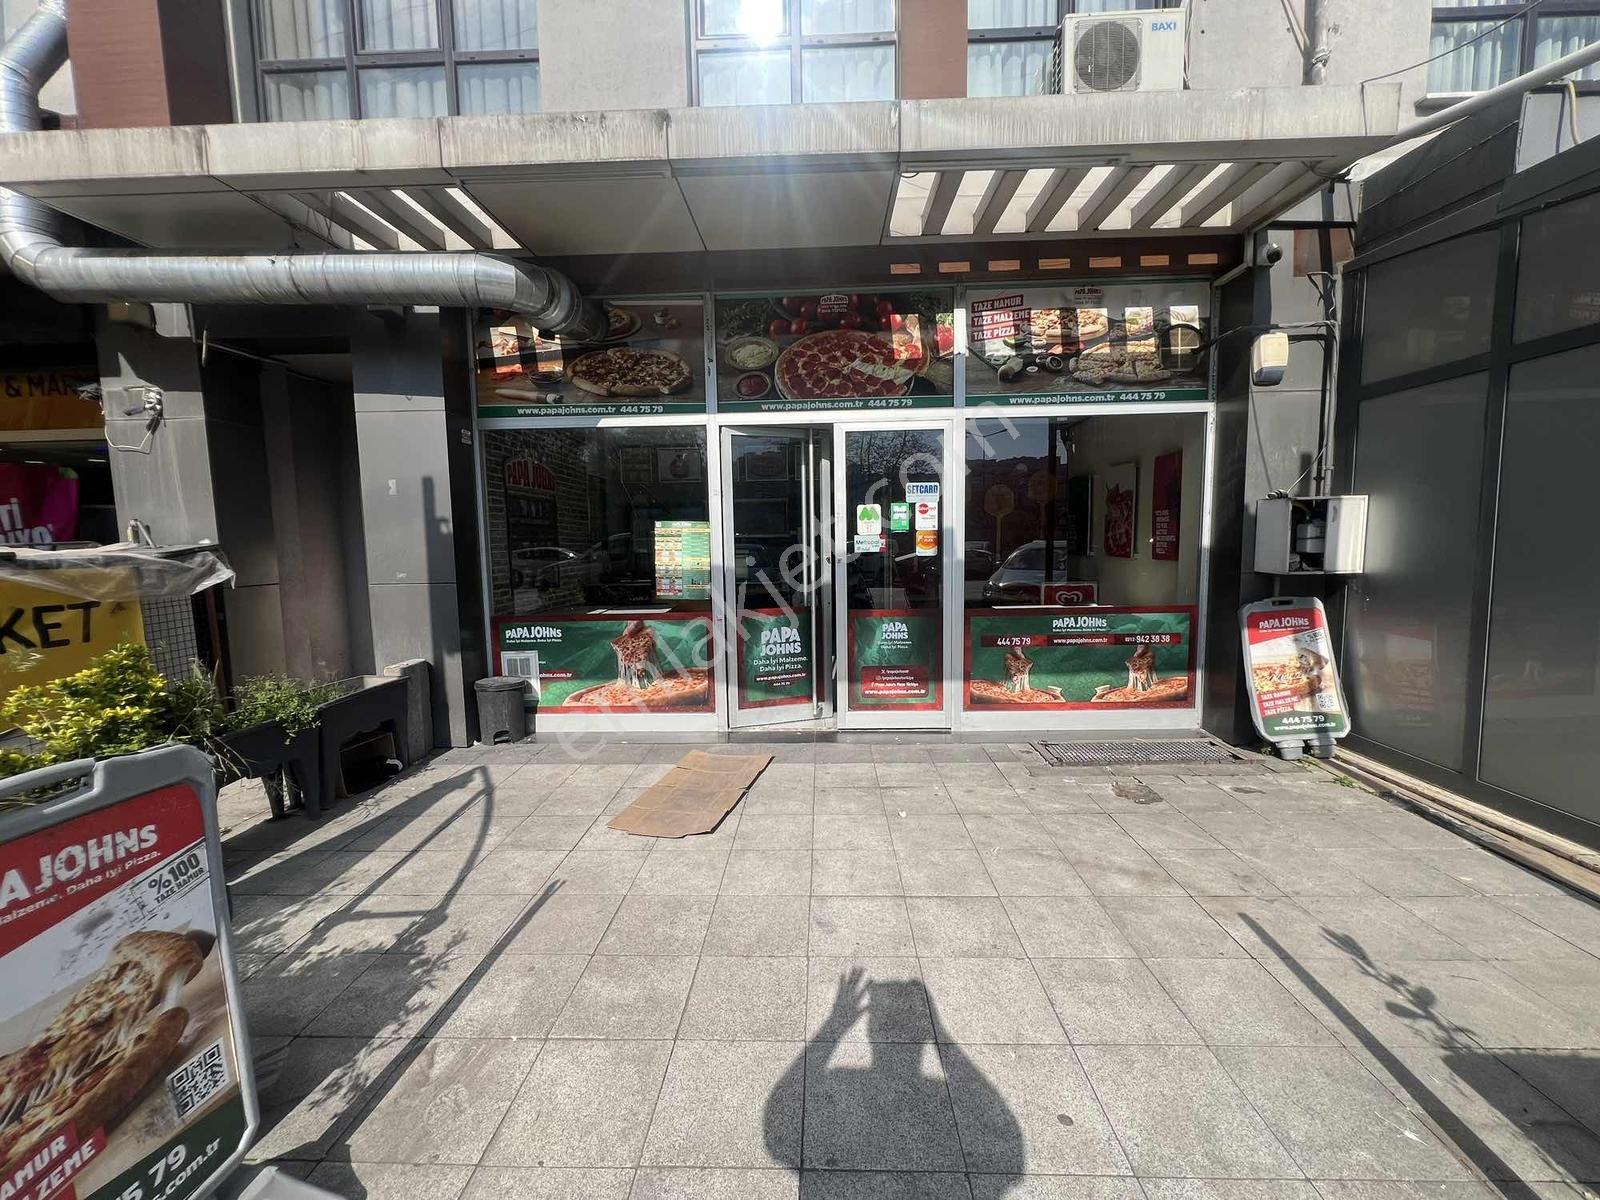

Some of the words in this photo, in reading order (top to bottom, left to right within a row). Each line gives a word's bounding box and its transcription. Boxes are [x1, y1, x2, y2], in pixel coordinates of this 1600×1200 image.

[1151, 22, 1177, 32] BAXI
[973, 301, 993, 311] TAZE
[993, 297, 1022, 310] HAMUR
[973, 315, 993, 326] TAZE
[993, 309, 1030, 324] MALZEME
[973, 330, 993, 340] TAZE
[5, 375, 21, 397] &
[1009, 393, 1116, 405] www.papajohns.com.tr
[1119, 393, 1139, 401] 444
[1140, 392, 1152, 401] 75
[1153, 391, 1166, 400] 79
[517, 406, 616, 416] www.papajohns.com.tr
[620, 406, 639, 414] 444
[639, 406, 651, 414] 75
[652, 406, 664, 414] 79
[761, 400, 864, 411] www.papajohns.com.tr
[888, 399, 900, 407] 75
[901, 399, 913, 407] 79
[907, 484, 939, 495] SETCARD
[882, 621, 909, 632] PAPA
[1052, 617, 1076, 628] PAPA
[1259, 618, 1281, 629] PAPA
[1281, 617, 1310, 627] JOHNS
[505, 626, 530, 639] PAPA
[760, 626, 801, 644] PAPA
[881, 631, 909, 640] JOHNS
[996, 637, 1011, 646] 444
[1011, 637, 1021, 645] 75
[1136, 636, 1150, 644] 942
[1150, 635, 1160, 643] 38
[1160, 635, 1171, 643] 38
[760, 642, 802, 657] JOHNS
[34, 824, 158, 895] JOHNS
[66, 875, 103, 895] Daha
[124, 851, 161, 870] Pizza.
[148, 852, 200, 895] %100
[154, 886, 177, 903] TAZE
[175, 867, 205, 889] HAMUR
[148, 1144, 187, 1189] 79
